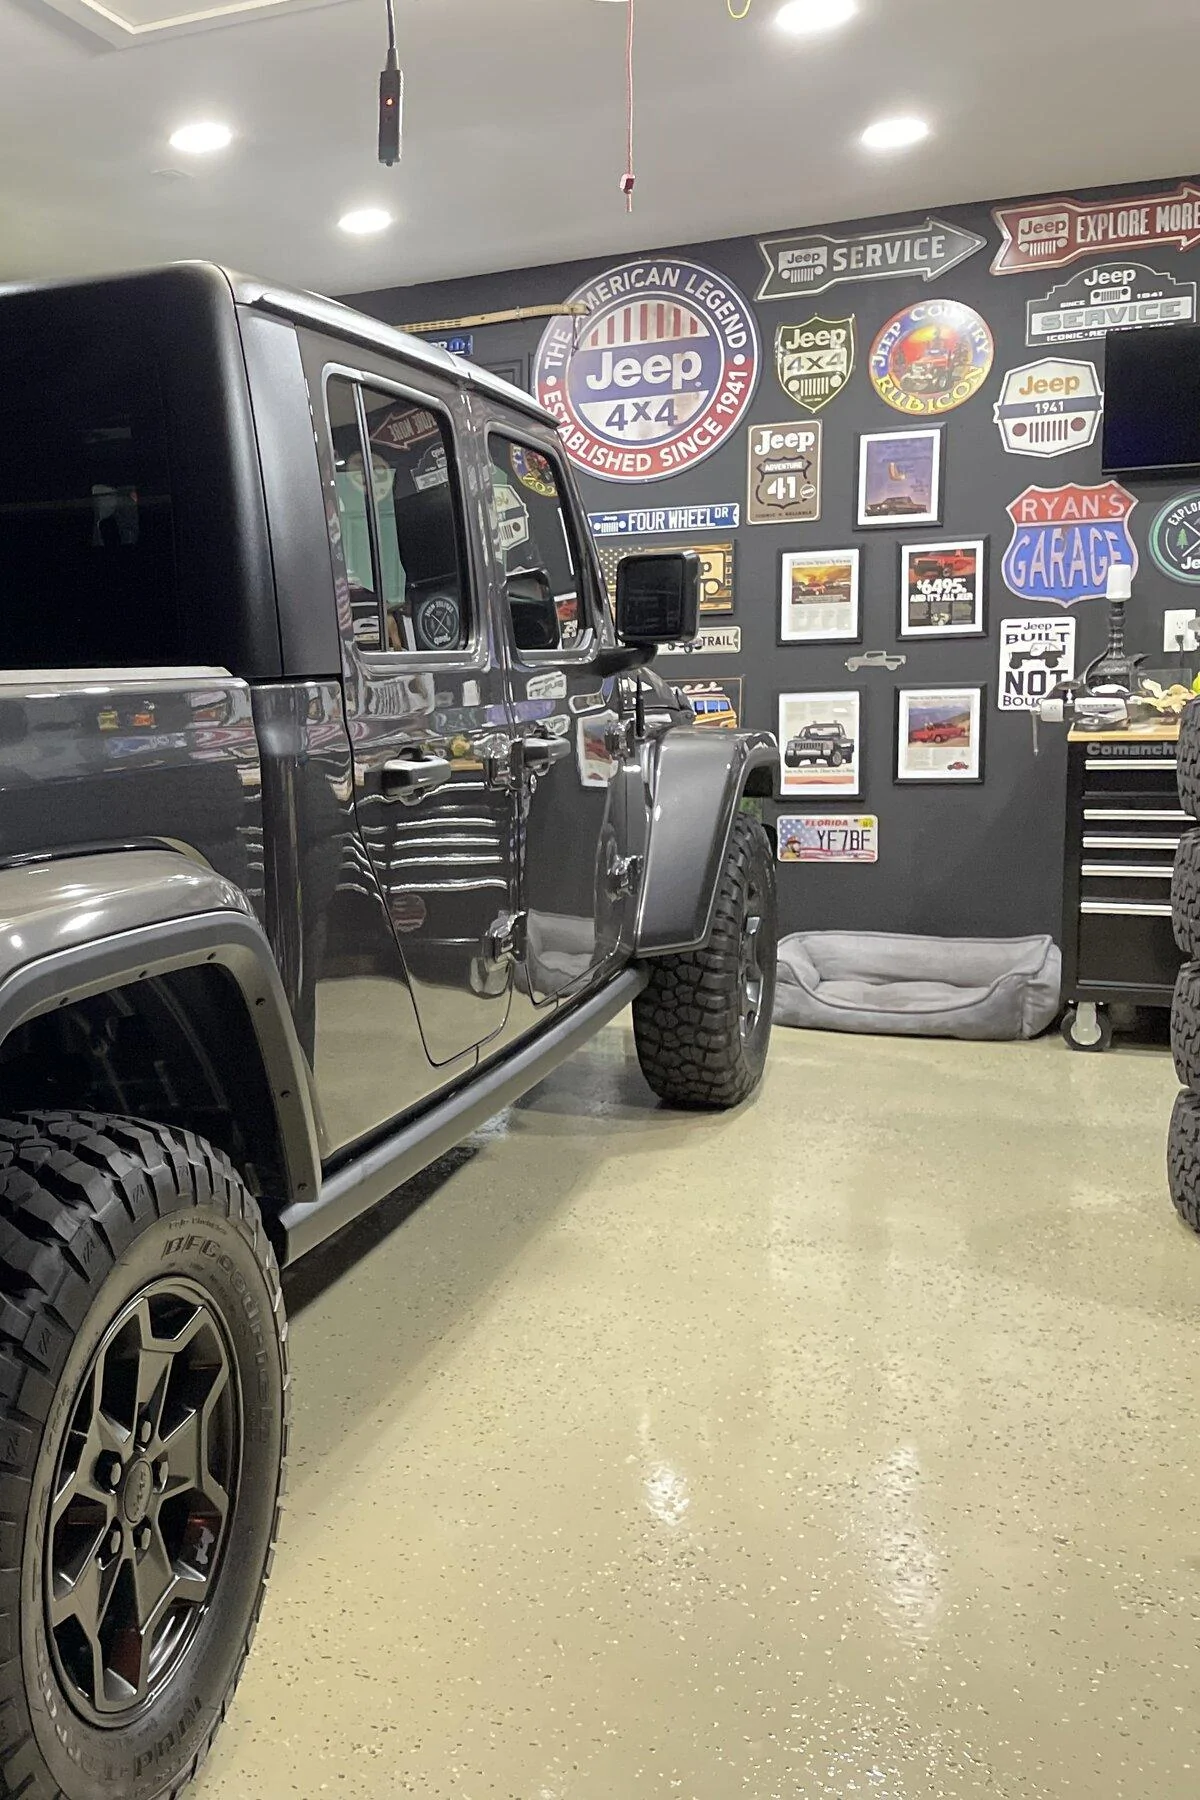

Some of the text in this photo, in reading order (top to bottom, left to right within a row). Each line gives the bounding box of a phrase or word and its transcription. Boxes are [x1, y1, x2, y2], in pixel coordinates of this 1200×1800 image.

[1021, 201, 1200, 243] Jeep EXPLORE MORE
[787, 235, 946, 272] Jeep SERVICE
[1084, 269, 1137, 286] Jeep
[1041, 301, 1181, 332] SERVICE
[1060, 300, 1086, 308] SINCE
[544, 267, 748, 370] THE MERICAN LEGEND
[786, 328, 847, 350] Jeep
[871, 304, 989, 368] JEEP COTRY
[586, 351, 702, 390] Jeep
[876, 368, 984, 414] RUBICON
[1019, 373, 1080, 397] Jeep
[1034, 402, 1065, 415] 1941
[543, 371, 748, 472] ESTABLISHED SINCE 1941
[754, 430, 815, 456] Jeep
[764, 461, 803, 472] ADVENTURE
[767, 476, 796, 500] 41
[628, 512, 665, 532] FOUR
[668, 508, 716, 530] WHEEL
[715, 507, 729, 519] DR
[1021, 494, 1125, 522] RYAN'S
[1167, 501, 1200, 526] EXPLO
[1009, 527, 1122, 589] GARAGE
[1005, 632, 1070, 645] BUILT
[1023, 621, 1052, 631] Jeep
[702, 635, 733, 646] TRAIL
[1005, 669, 1068, 695] NOT
[1086, 742, 1177, 756] Comanch
[805, 819, 849, 827] FLORIDA
